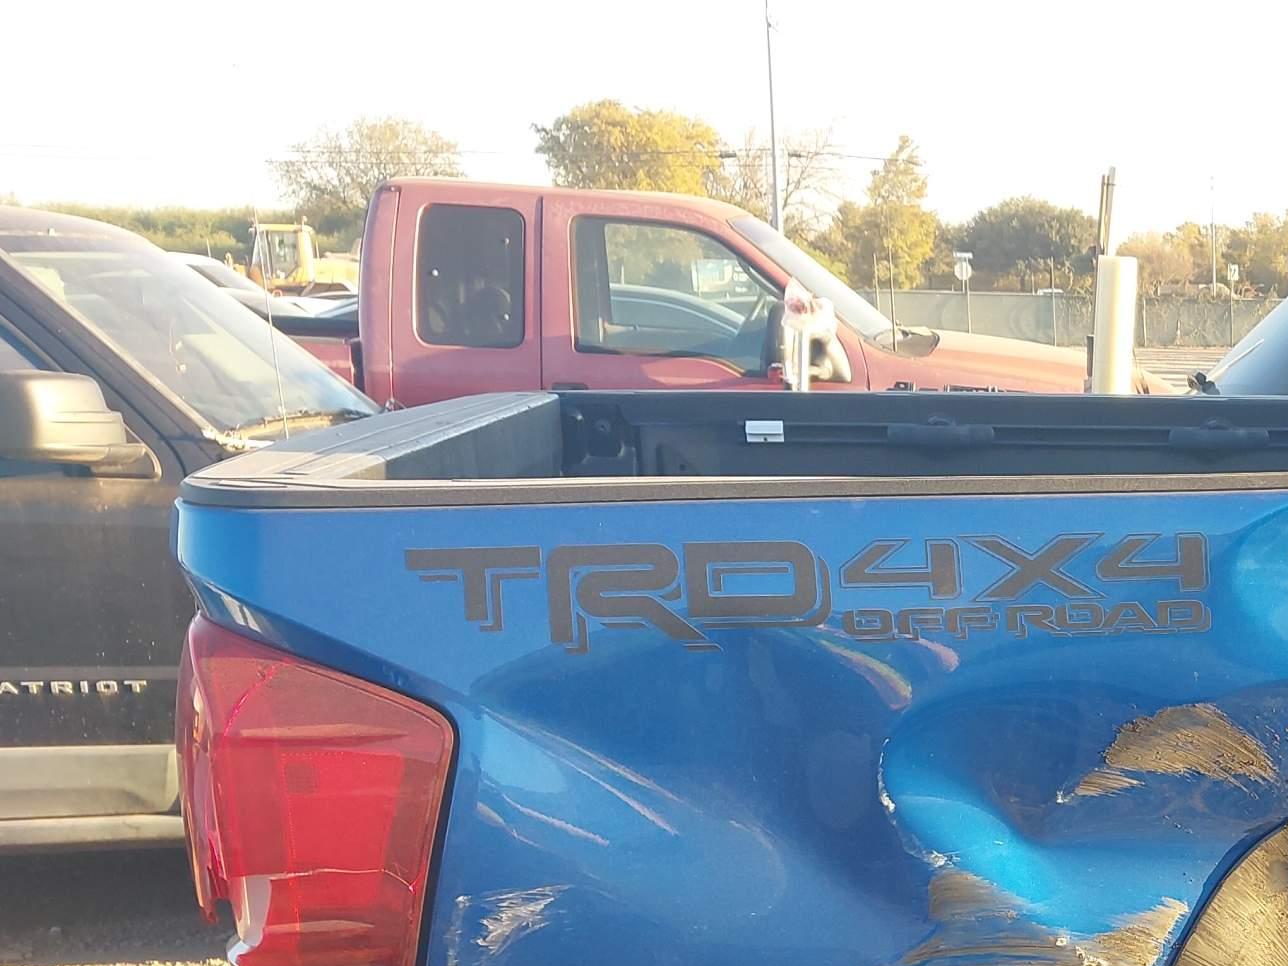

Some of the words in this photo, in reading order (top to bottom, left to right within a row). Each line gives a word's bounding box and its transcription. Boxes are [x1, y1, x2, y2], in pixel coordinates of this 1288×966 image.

[405, 541, 832, 654] TRD
[839, 532, 1211, 601] 4X4
[843, 606, 999, 640] OFF
[1006, 600, 1211, 638] ROAD
